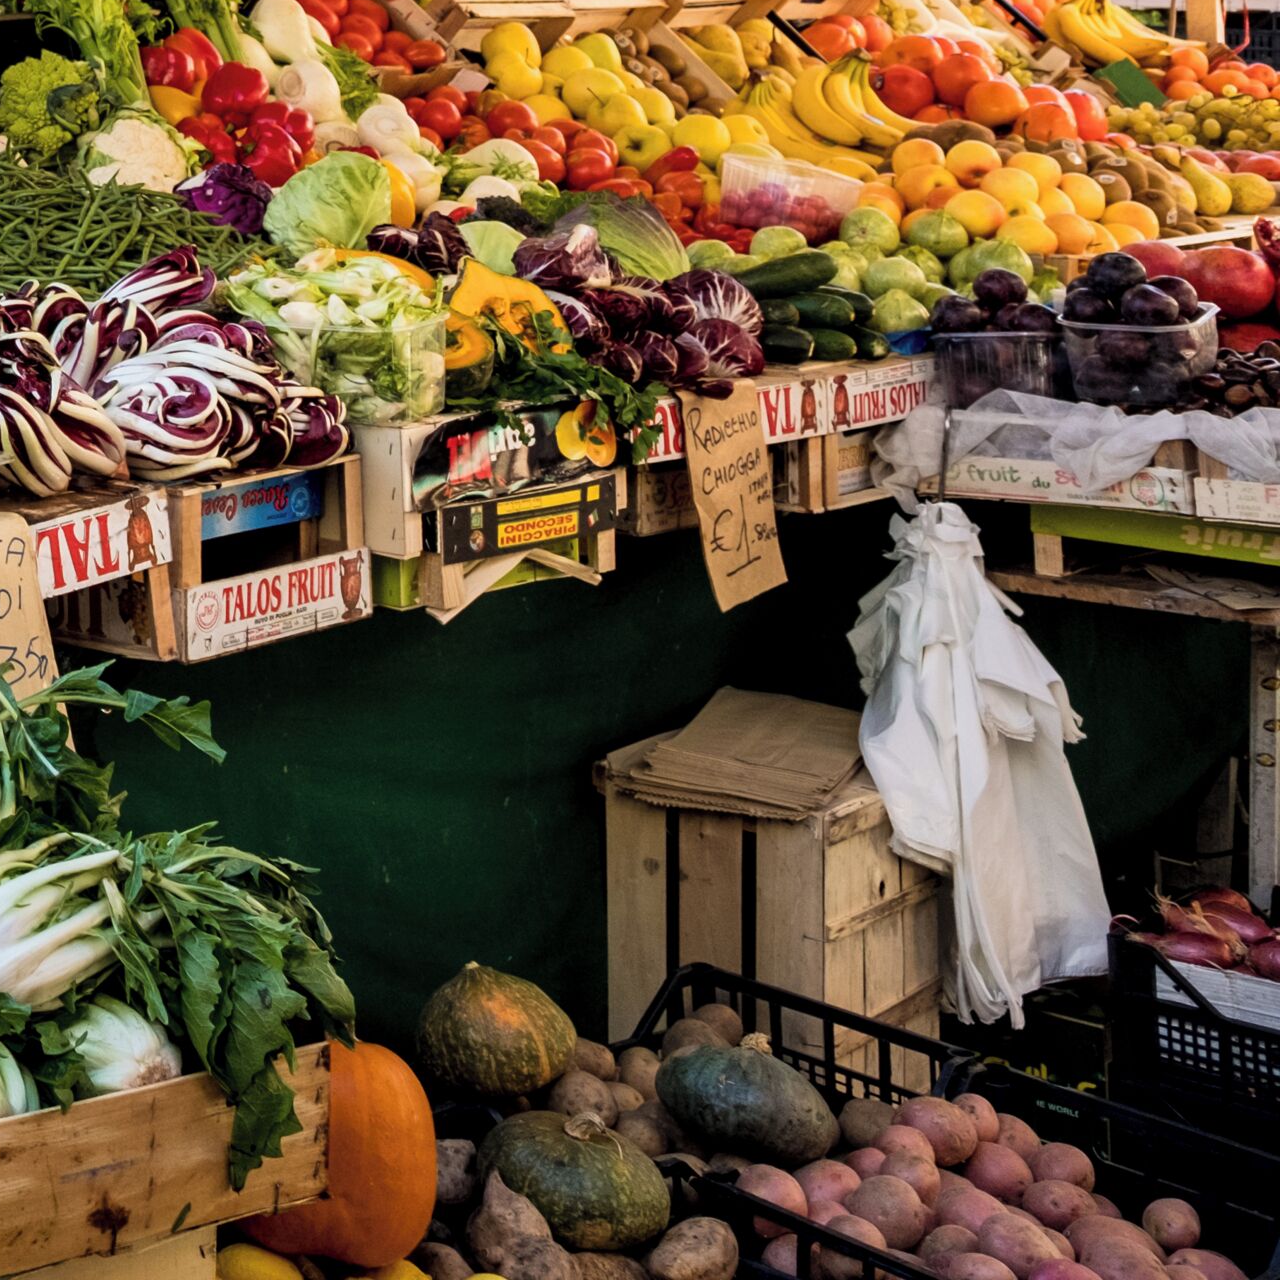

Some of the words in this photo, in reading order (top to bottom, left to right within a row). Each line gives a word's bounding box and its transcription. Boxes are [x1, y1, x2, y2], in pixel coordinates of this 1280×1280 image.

[852, 388, 887, 425] FRUIT
[1032, 477, 1050, 489] du
[241, 483, 290, 512] Rocco
[500, 522, 578, 547] PIRACCINI
[503, 513, 574, 534] SECONDO
[222, 574, 282, 625] TALOS
[287, 561, 337, 609] FRUIT
